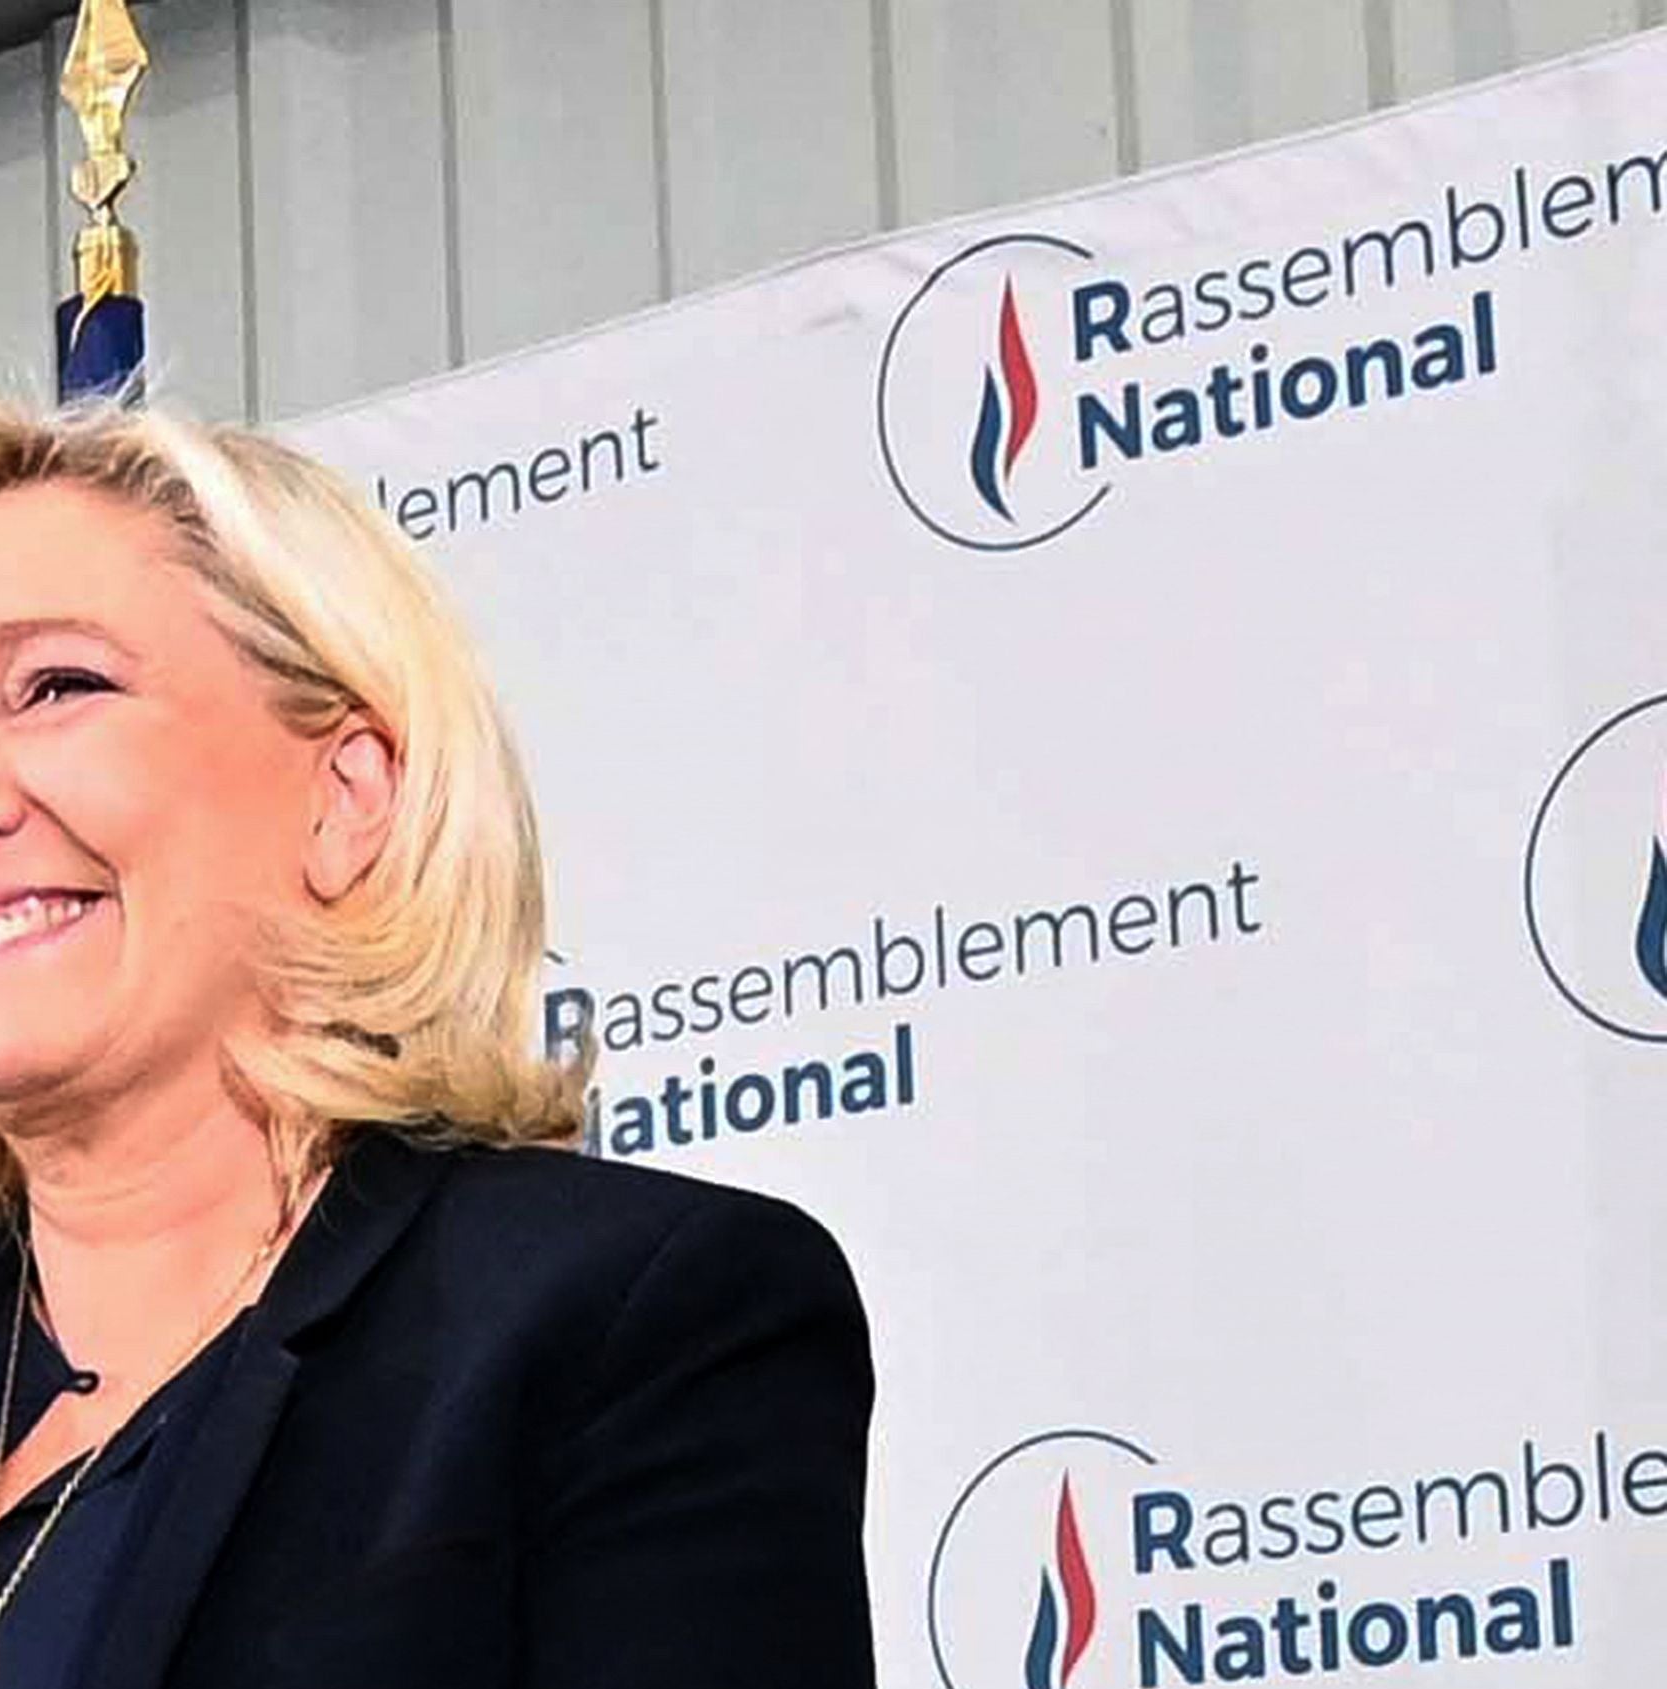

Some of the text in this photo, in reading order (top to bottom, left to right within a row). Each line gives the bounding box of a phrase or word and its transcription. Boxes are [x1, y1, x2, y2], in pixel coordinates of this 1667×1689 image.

[1078, 291, 1497, 469] National
[544, 861, 1262, 1061] Rassemblement
[1133, 1431, 1667, 1574] Rassemble
[1138, 1558, 1574, 1689] National
